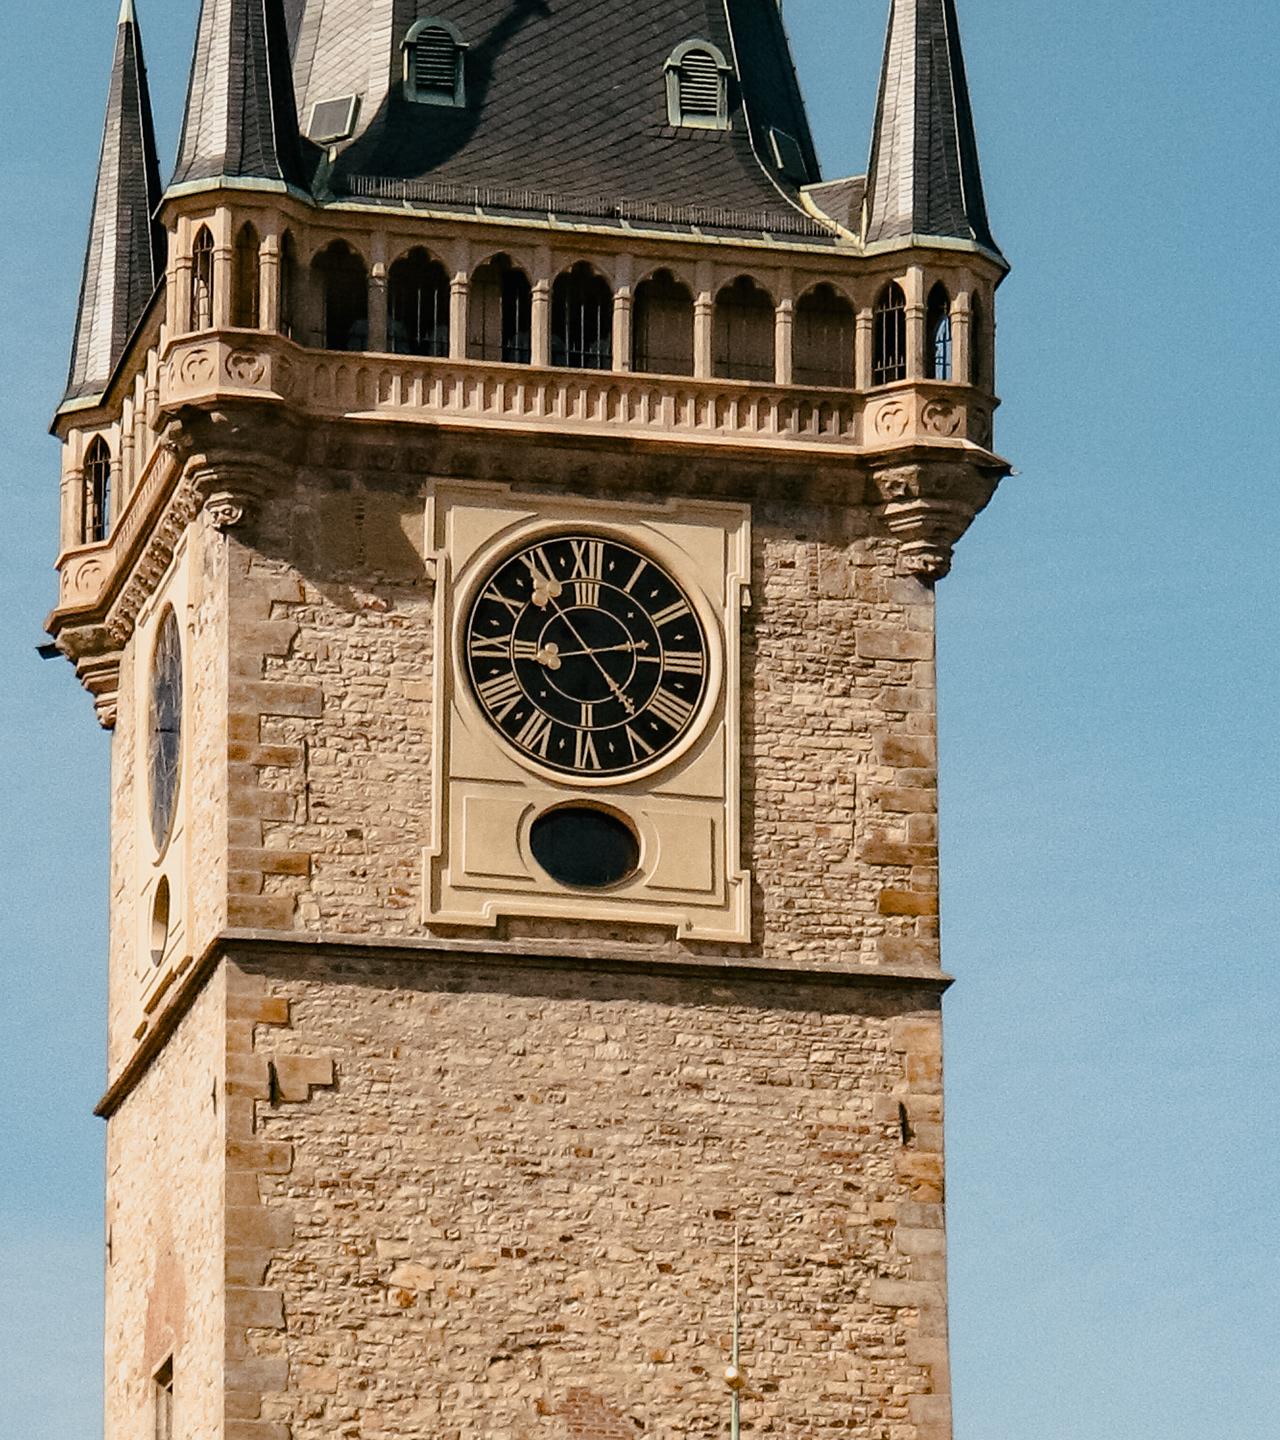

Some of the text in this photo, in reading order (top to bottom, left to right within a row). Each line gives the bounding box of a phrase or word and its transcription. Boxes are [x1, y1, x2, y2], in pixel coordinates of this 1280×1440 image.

[570, 540, 604, 580] XII
[624, 559, 647, 593] I
[483, 582, 525, 619] X
[651, 598, 690, 627] II
[470, 631, 511, 658] IX
[664, 650, 702, 676] III
[478, 672, 523, 723] VIII
[515, 709, 552, 758] VII
[574, 730, 602, 769] VI
[625, 724, 656, 762] V
